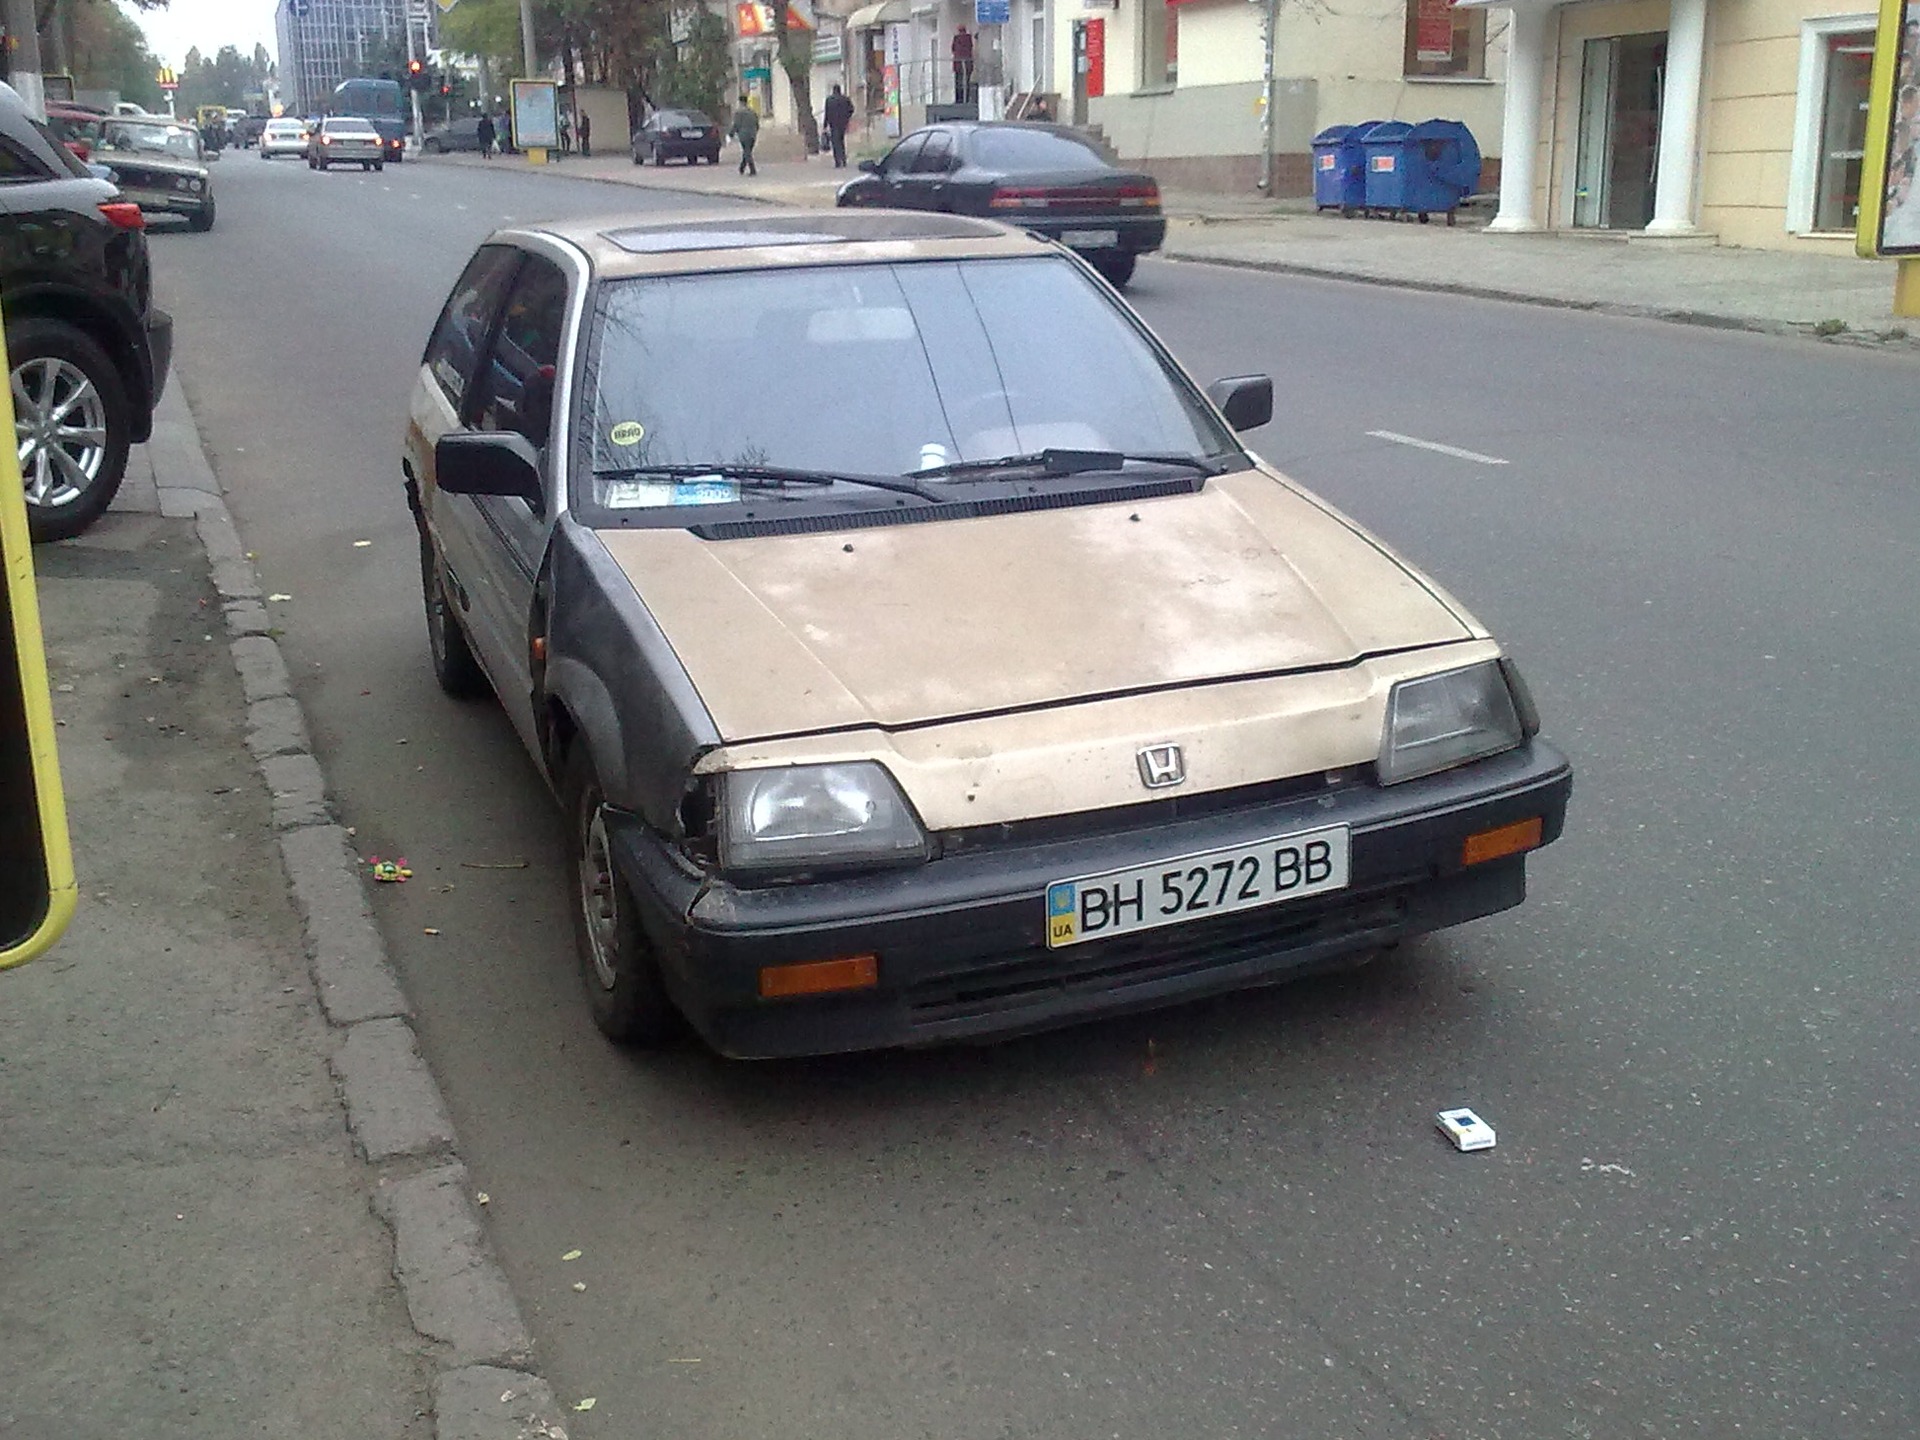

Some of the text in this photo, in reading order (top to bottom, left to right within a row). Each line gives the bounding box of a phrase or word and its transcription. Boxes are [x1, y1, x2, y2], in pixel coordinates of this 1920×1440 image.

[1081, 840, 1332, 933] BH 5272 BB
[1053, 923, 1074, 938] UA
